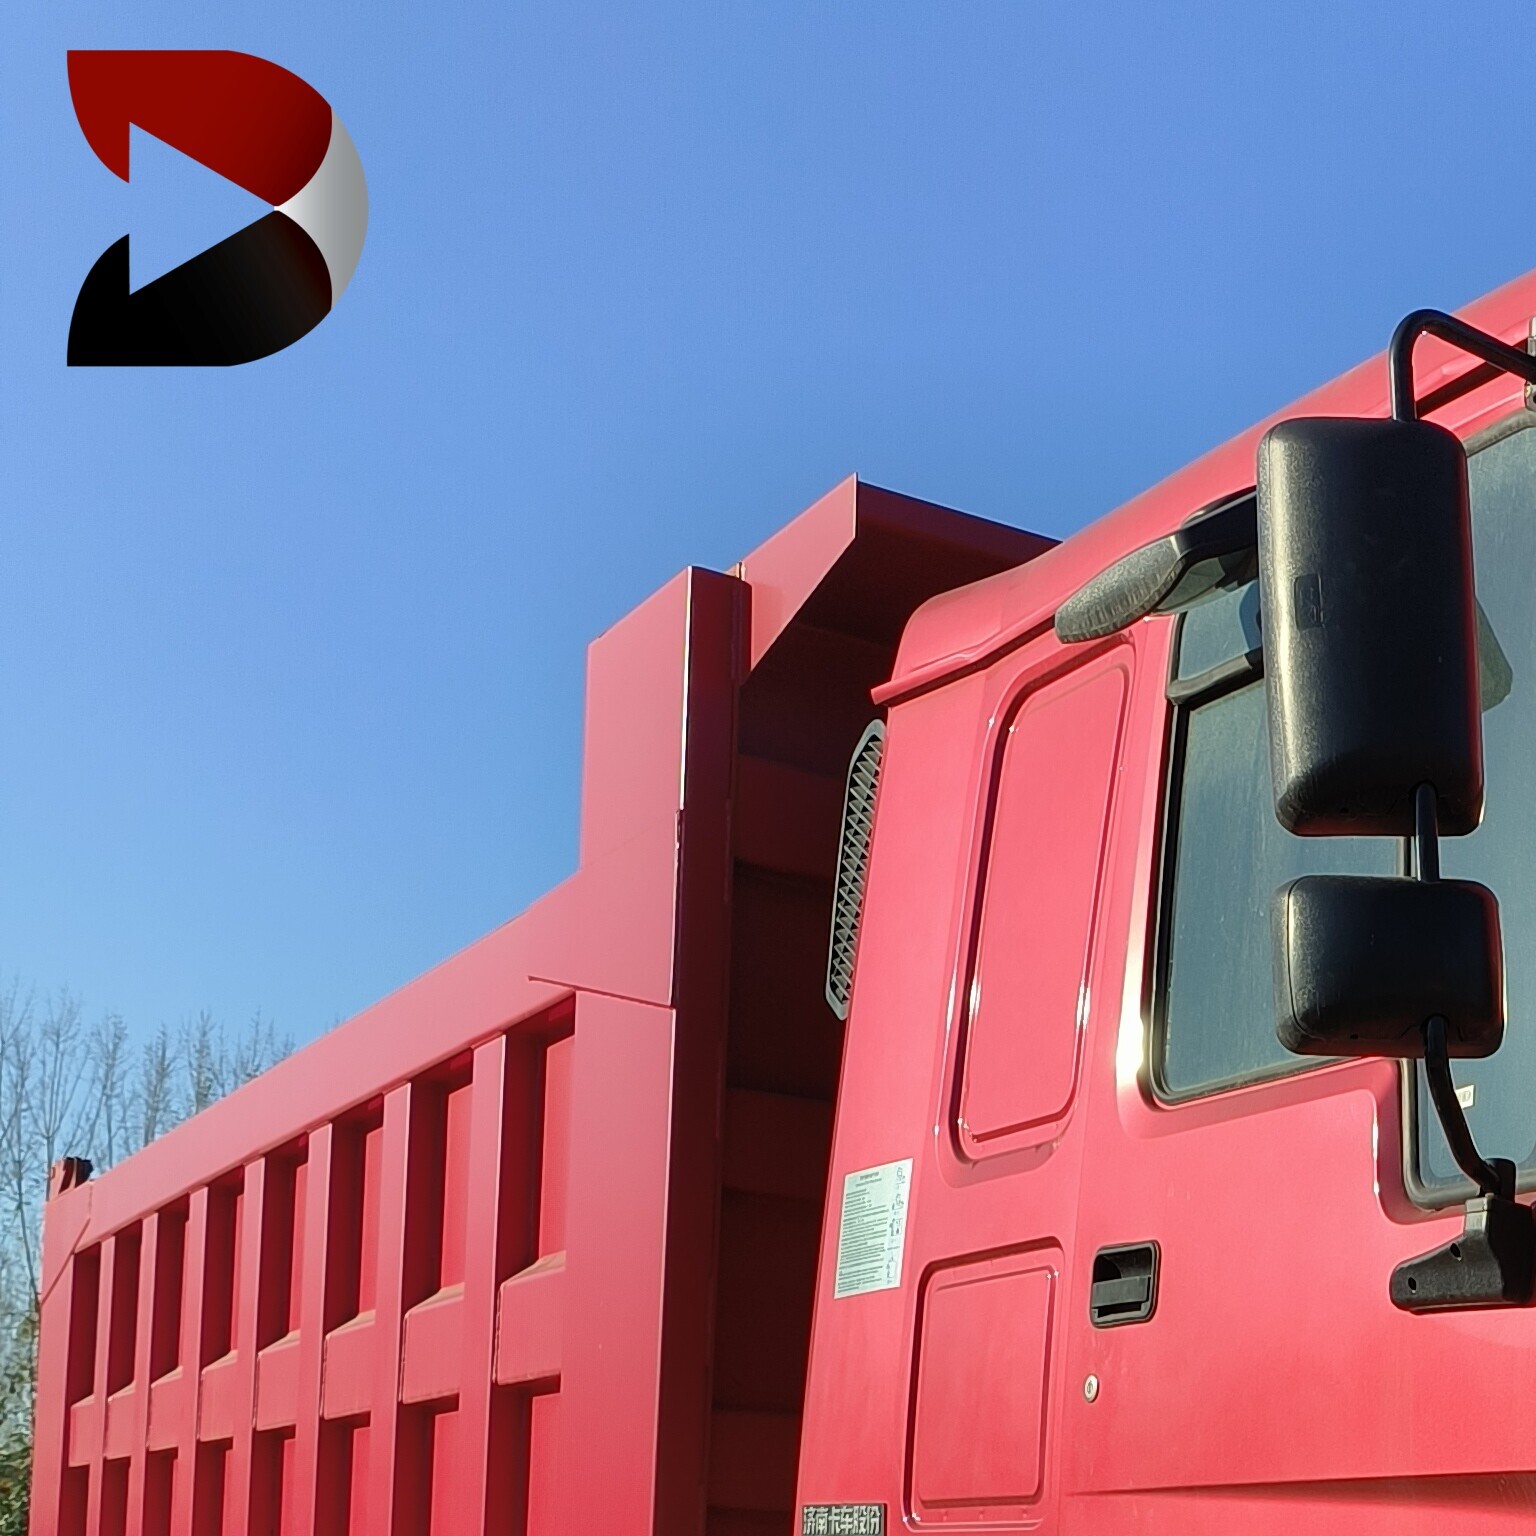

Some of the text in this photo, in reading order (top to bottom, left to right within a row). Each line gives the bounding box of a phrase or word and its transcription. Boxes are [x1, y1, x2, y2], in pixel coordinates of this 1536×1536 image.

[803, 1505, 881, 1535] 济南卡车股份
